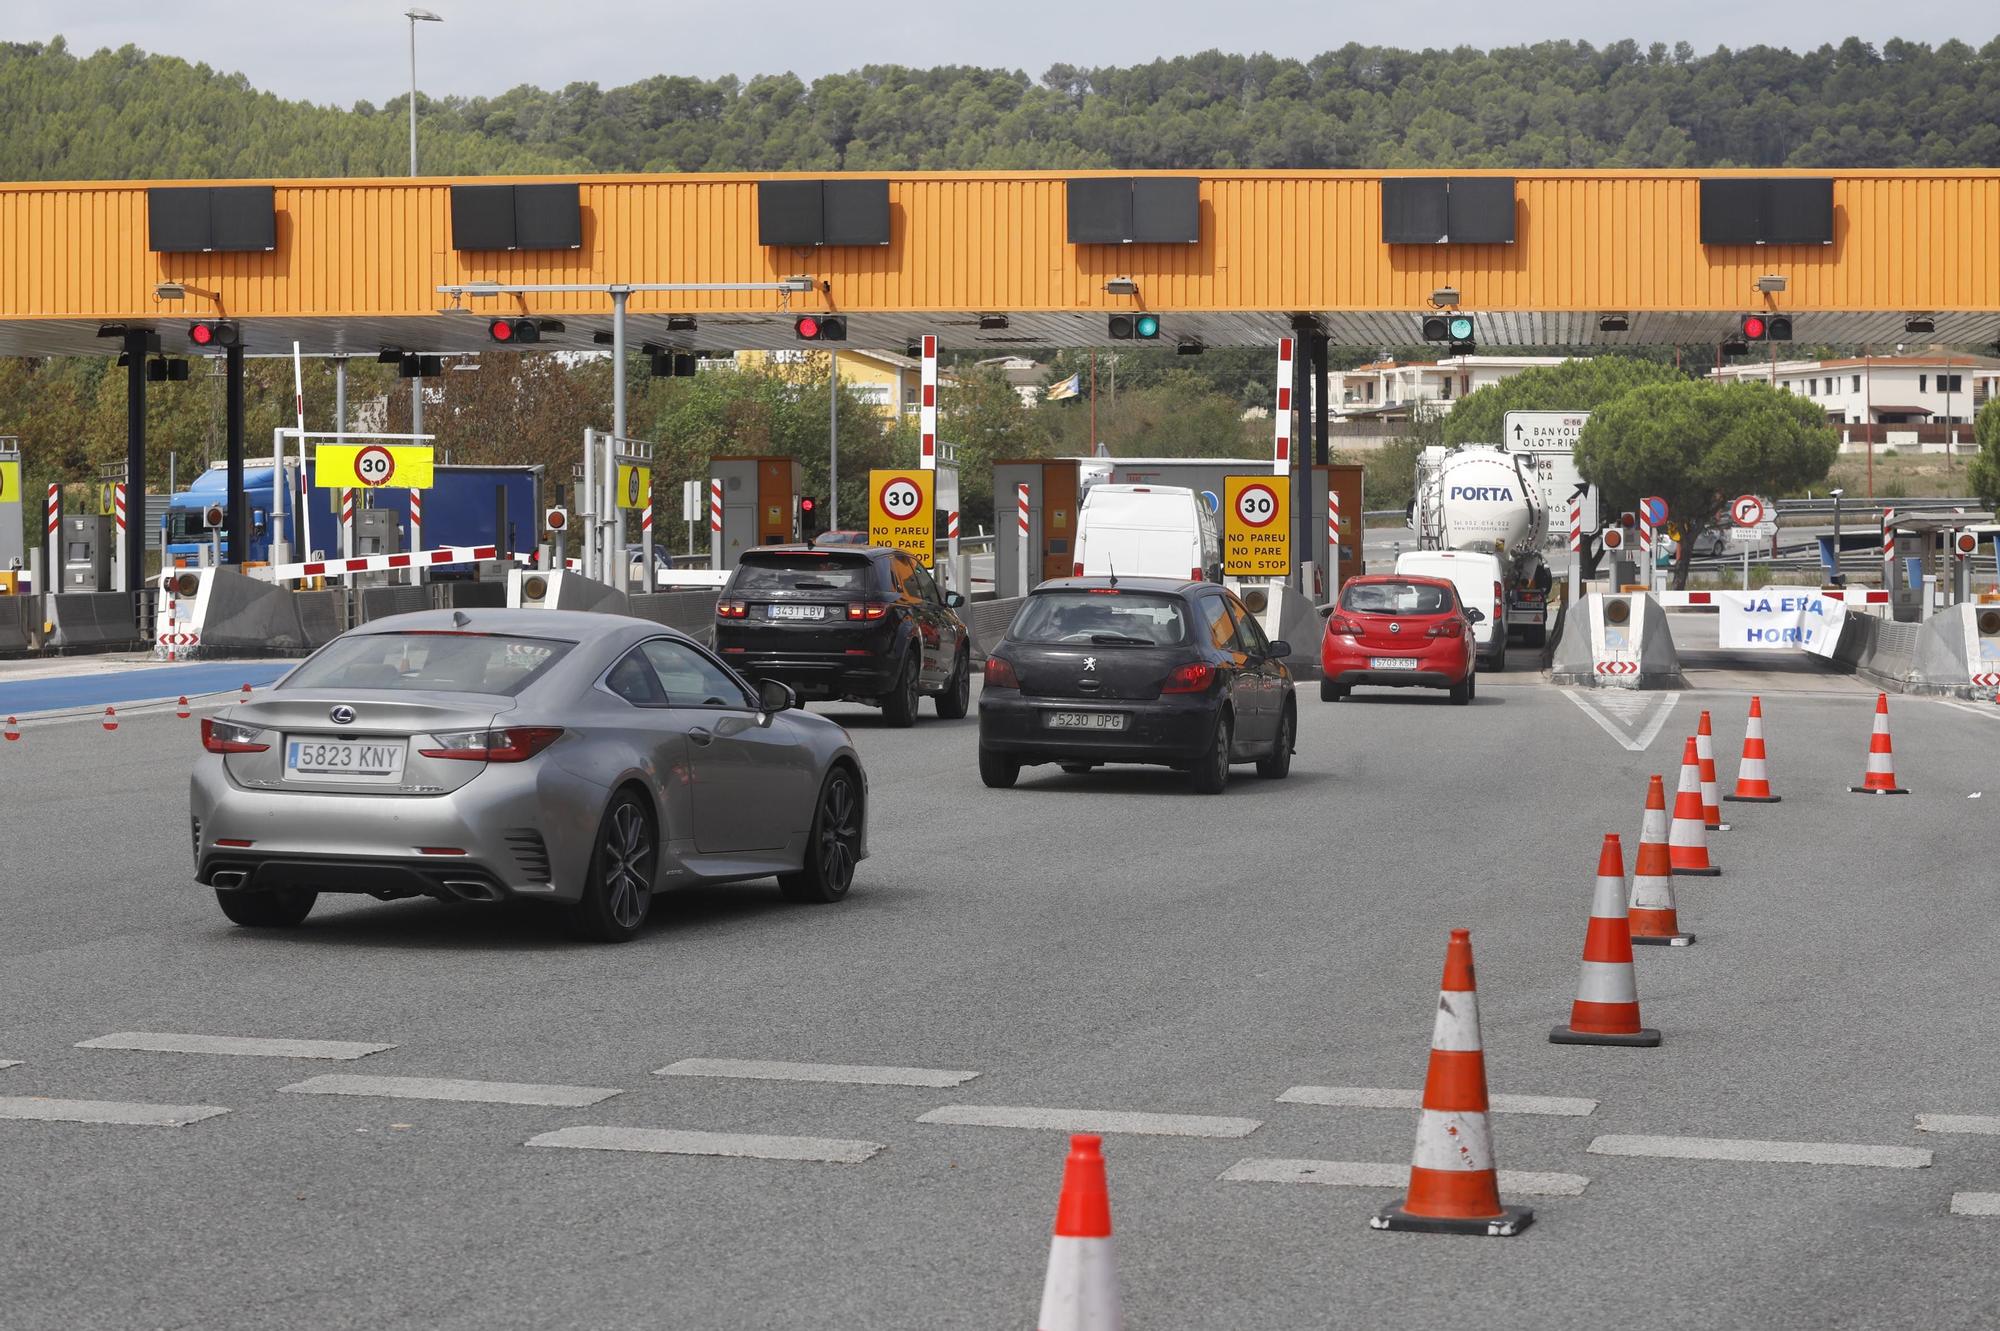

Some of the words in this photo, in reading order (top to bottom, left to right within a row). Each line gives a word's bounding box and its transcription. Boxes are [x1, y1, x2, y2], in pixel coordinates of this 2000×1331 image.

[1533, 427, 1584, 436] BANYOLE
[1523, 438, 1576, 447] OLOT-RIP
[362, 459, 387, 473] 30
[888, 491, 915, 507] 30
[1450, 486, 1514, 502] PORTA
[1244, 498, 1271, 514] 30
[872, 527, 889, 535] NO
[894, 527, 929, 535] PAREU
[1228, 533, 1245, 542] NO
[1250, 533, 1286, 542] PAREU
[876, 540, 893, 548] NO
[898, 540, 926, 549] PARE
[1232, 547, 1249, 556] NO
[1254, 547, 1282, 556] PARE
[1227, 560, 1252, 569] NON
[1258, 560, 1287, 569] STOP
[1743, 599, 1772, 613] JA
[1780, 594, 1823, 617] ERA
[775, 606, 799, 616] 3431
[803, 606, 822, 616] LBV
[1058, 713, 1089, 726] 5230
[1096, 714, 1120, 728] DPG
[302, 745, 352, 767] 5823
[359, 746, 398, 768] KNY
